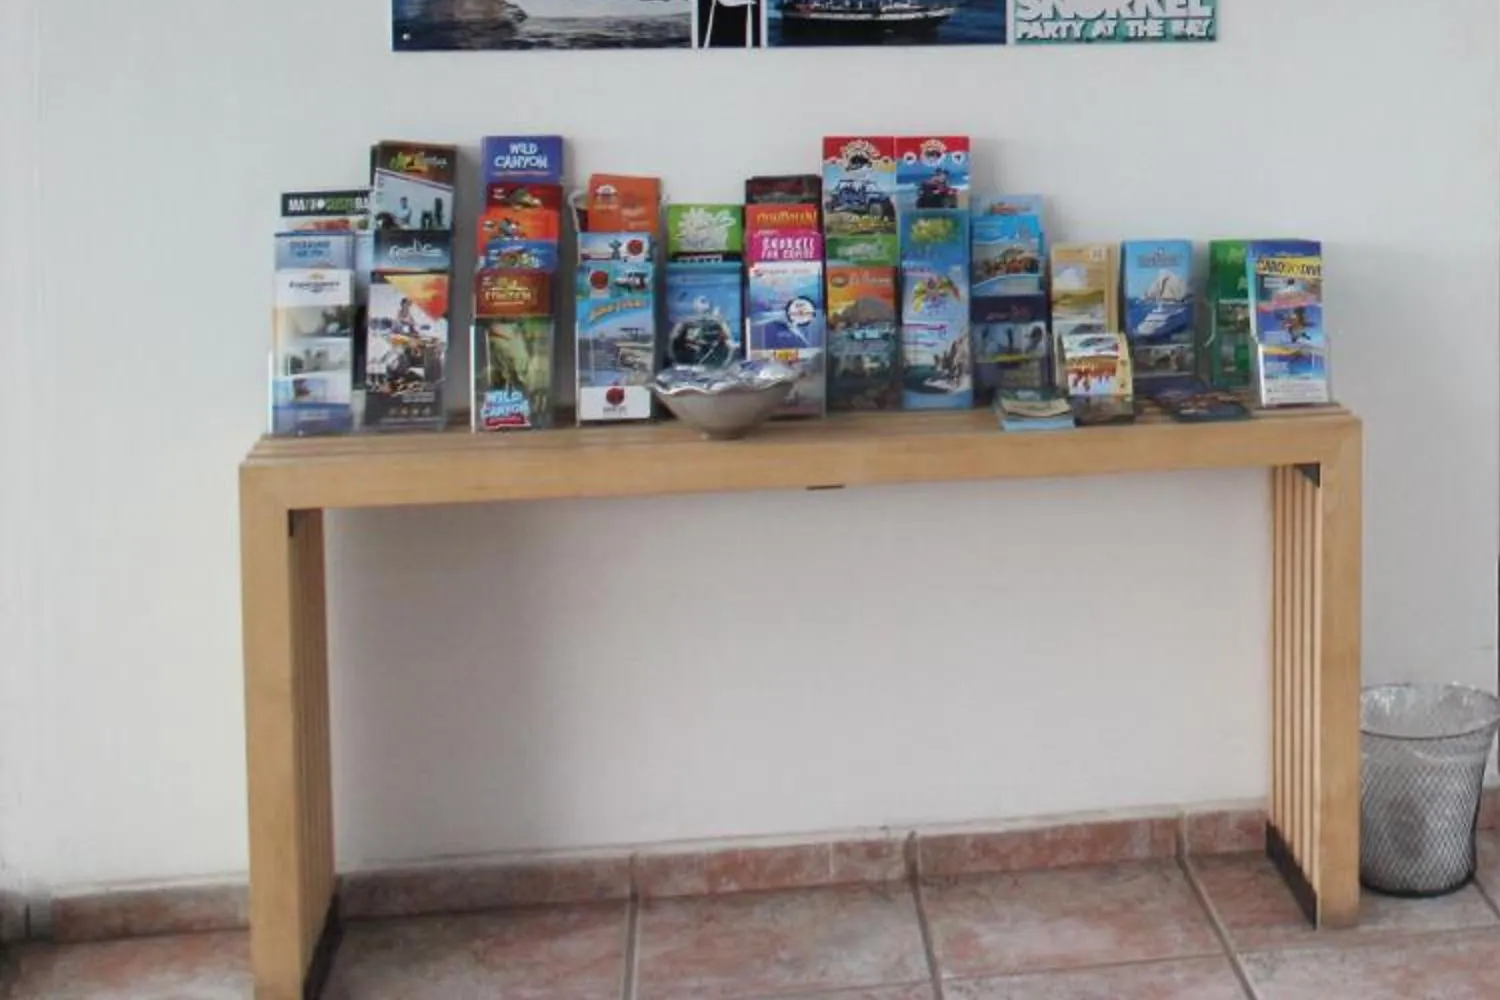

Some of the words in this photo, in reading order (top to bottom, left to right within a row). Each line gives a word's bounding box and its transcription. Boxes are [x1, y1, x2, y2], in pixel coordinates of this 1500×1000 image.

[1016, 20, 1087, 39] PARTY
[1127, 21, 1165, 37] THE
[509, 142, 539, 155] WILD
[494, 154, 548, 169] CANYON
